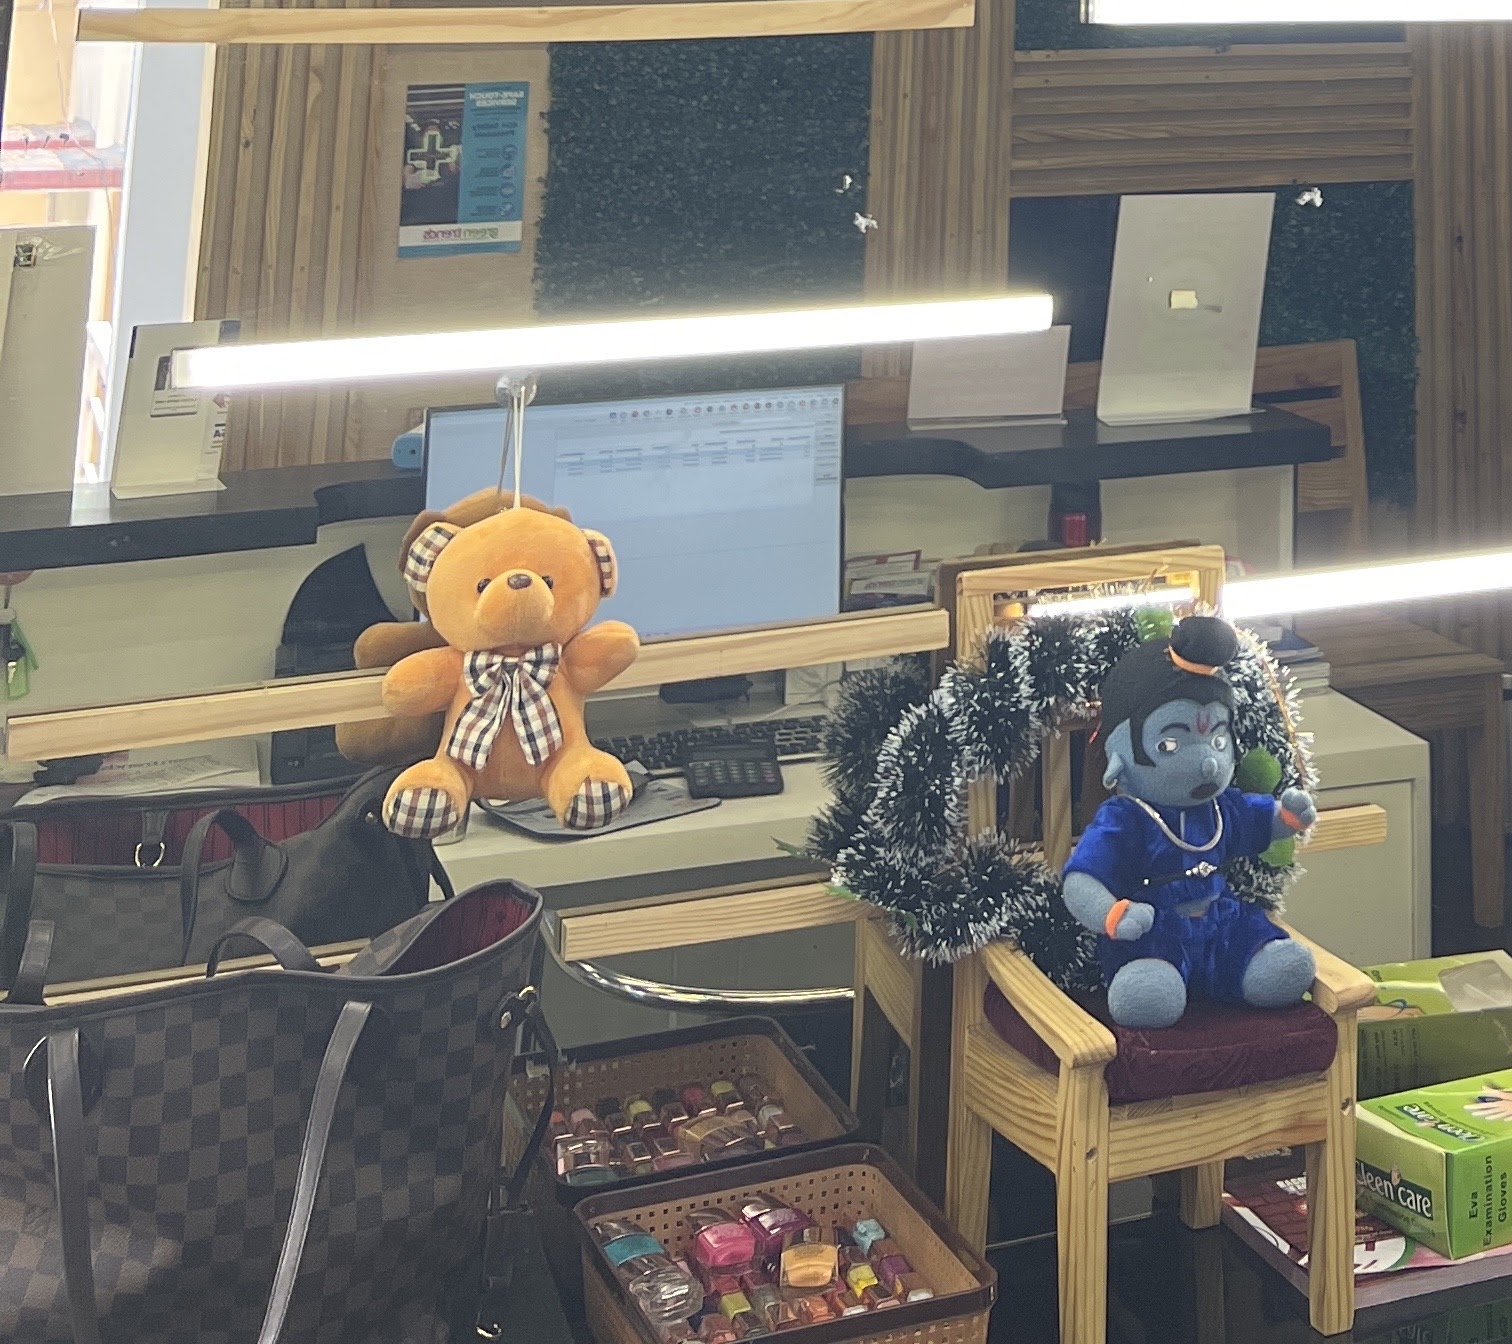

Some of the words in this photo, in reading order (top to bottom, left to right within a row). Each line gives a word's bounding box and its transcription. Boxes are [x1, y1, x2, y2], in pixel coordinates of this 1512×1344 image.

[1398, 1186, 1432, 1218] care
[1469, 1191, 1478, 1219] Eva
[1483, 1155, 1493, 1247] Examination
[1497, 1171, 1508, 1223] Gloves
